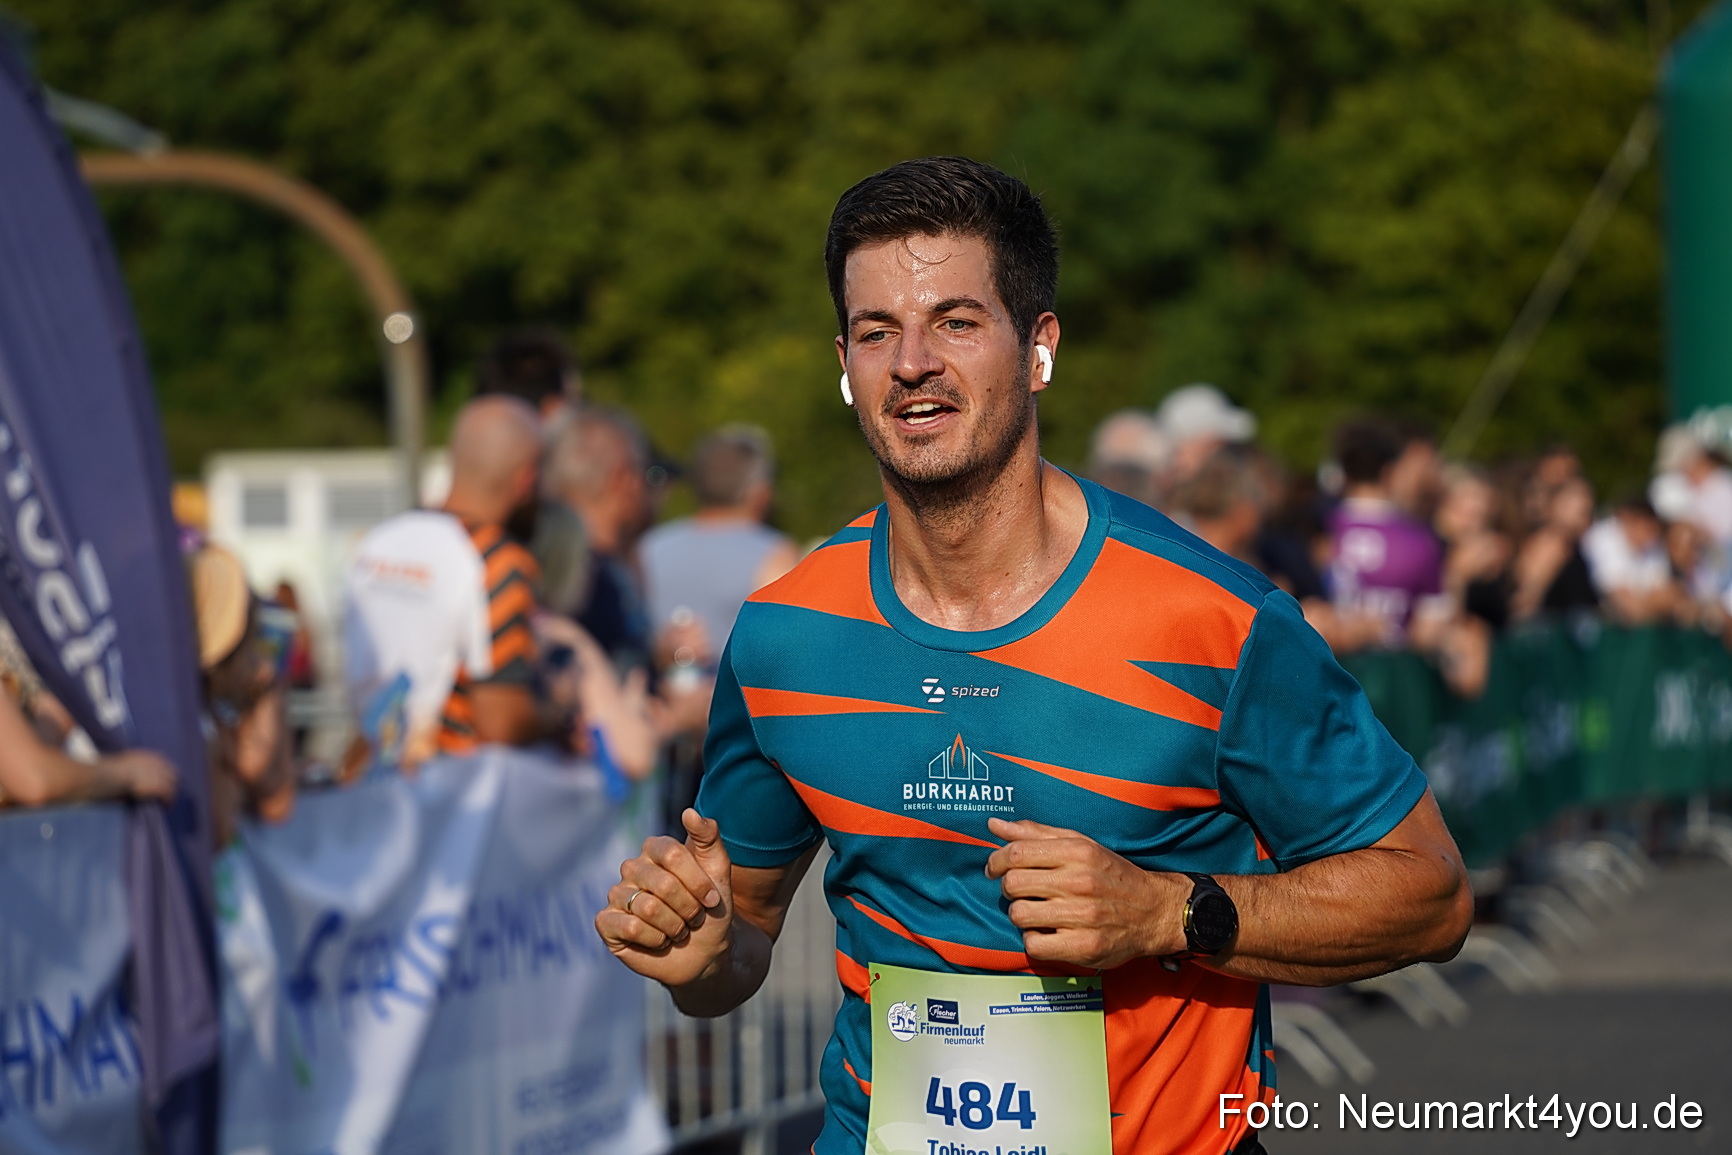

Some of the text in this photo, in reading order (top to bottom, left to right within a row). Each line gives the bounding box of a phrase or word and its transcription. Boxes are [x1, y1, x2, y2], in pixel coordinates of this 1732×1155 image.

[951, 684, 1000, 698] spized
[903, 782, 1014, 802] BURKHARDT
[903, 802, 1015, 813] ENERGIE- UND GEBÄUDETECHNIK
[920, 1022, 985, 1037] Firmenlauf
[944, 1036, 985, 1045] neumarkt
[926, 1077, 1037, 1131] 484
